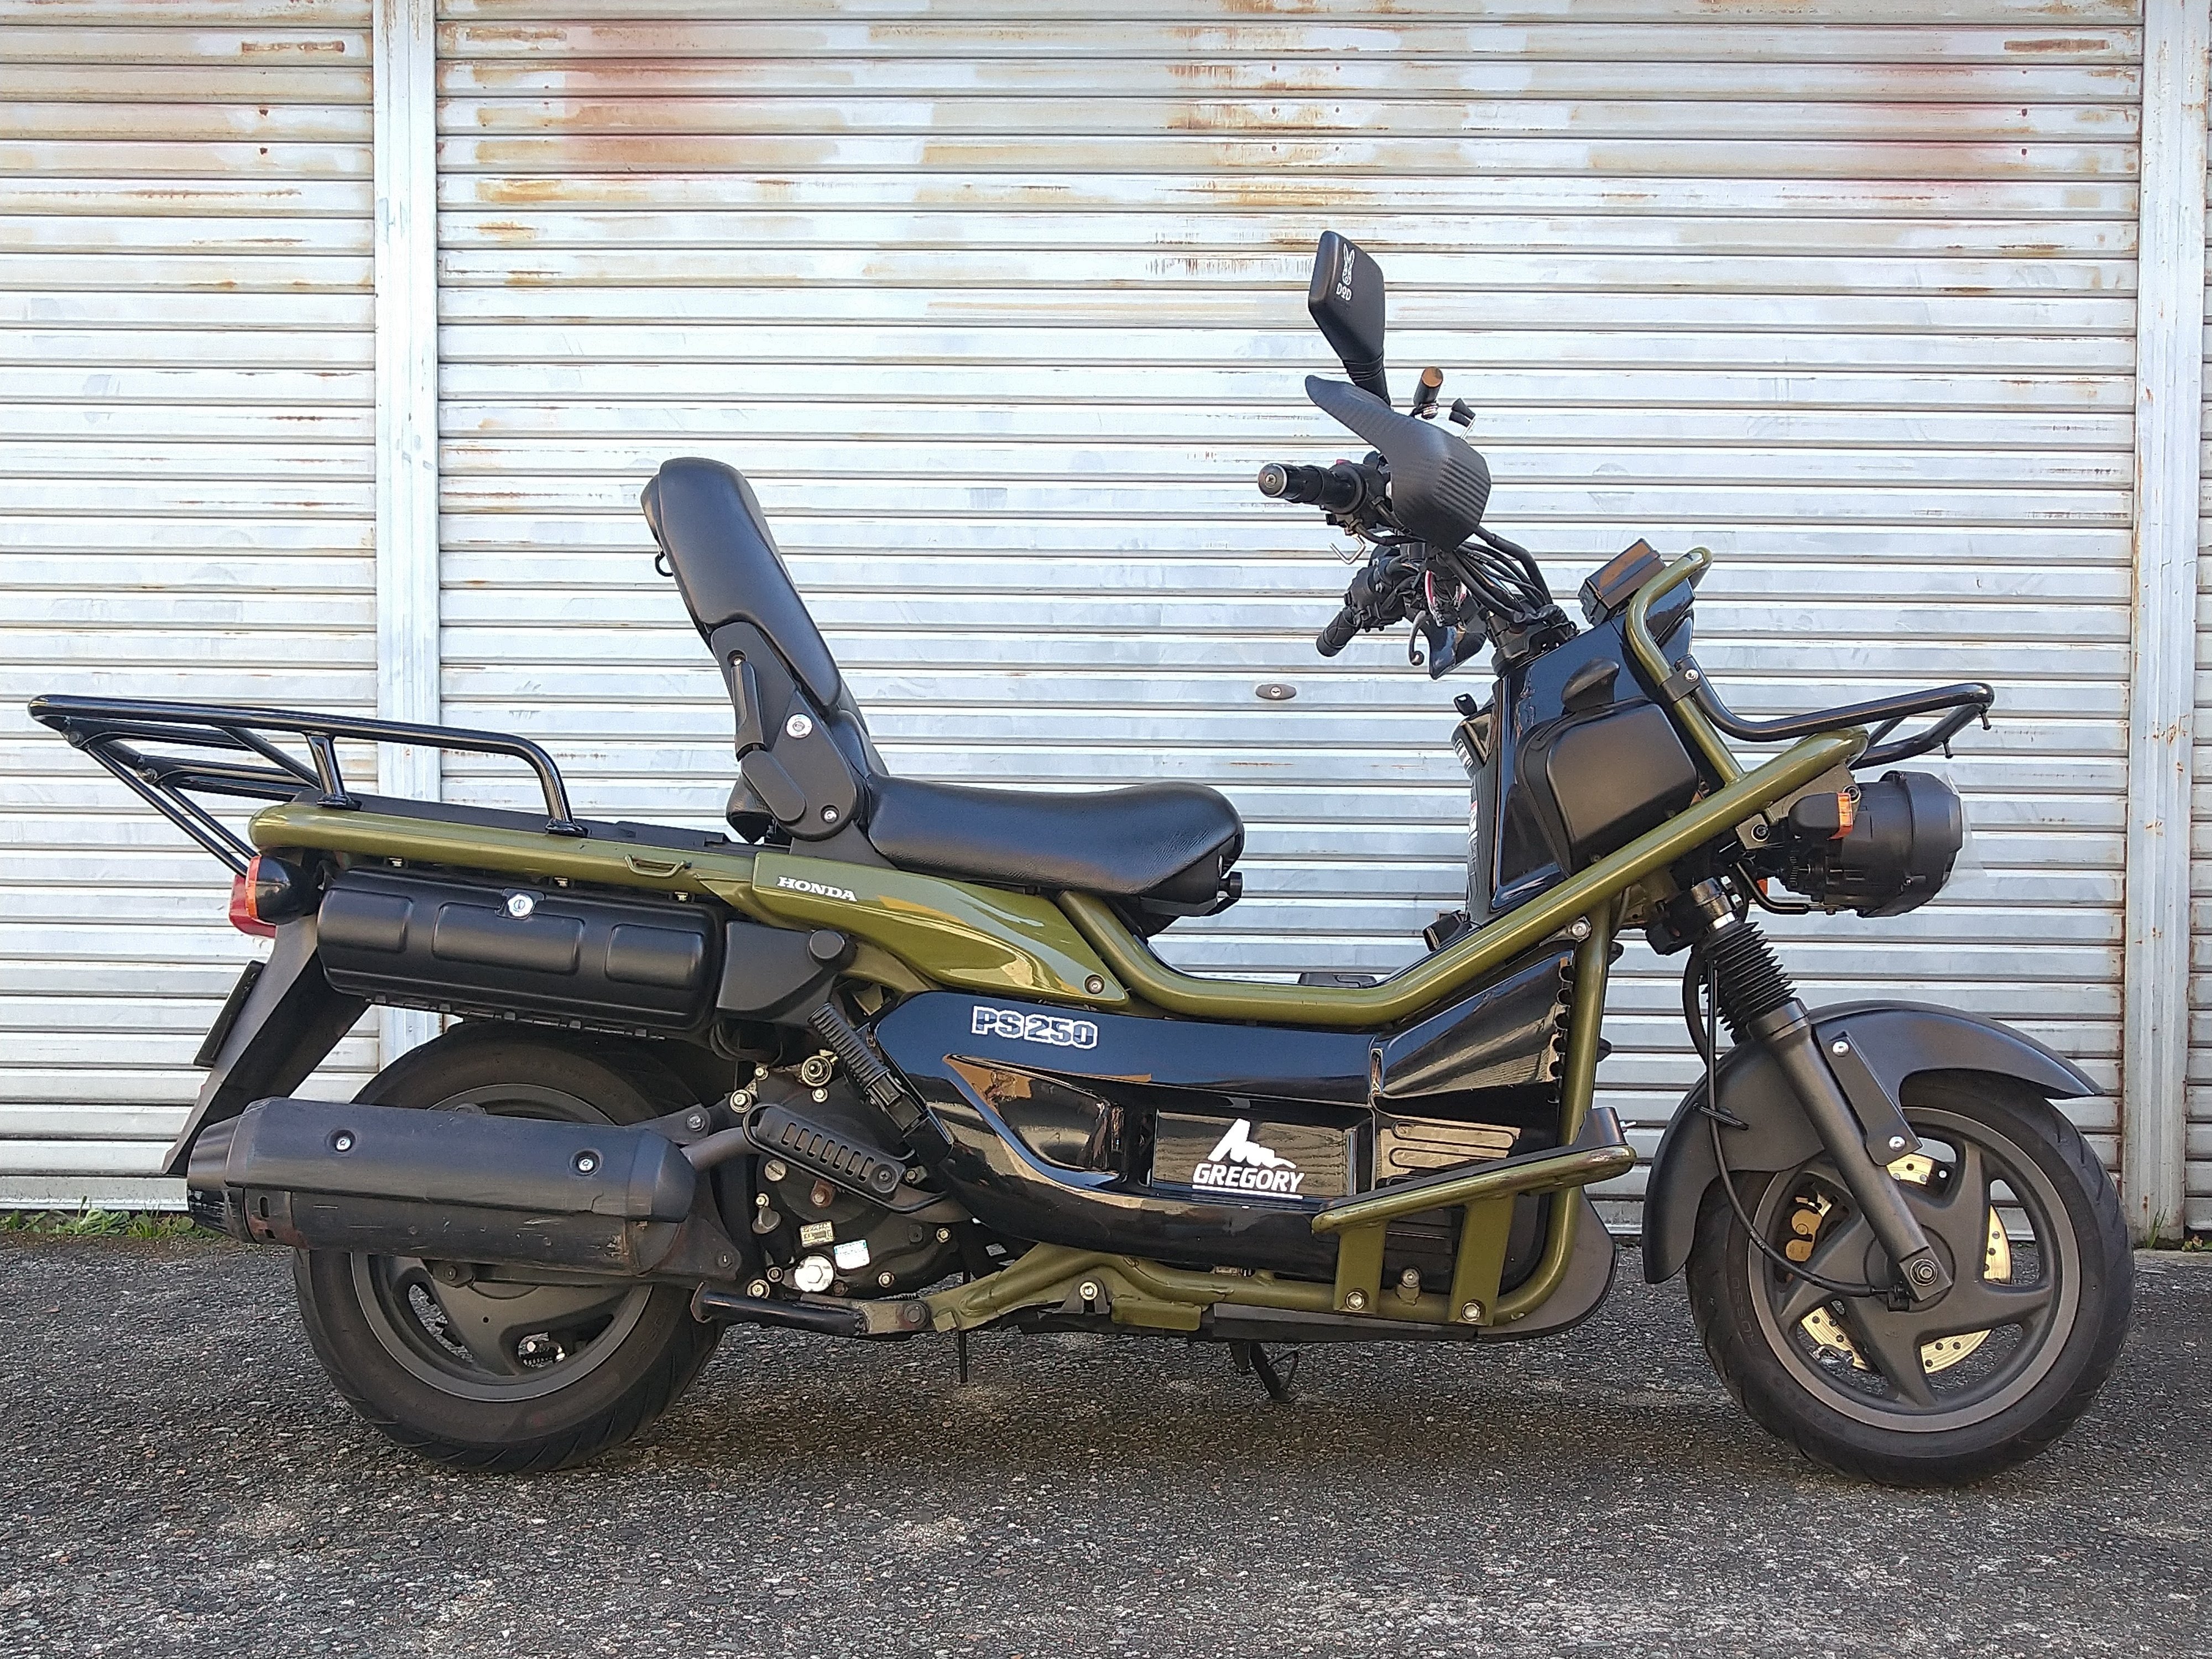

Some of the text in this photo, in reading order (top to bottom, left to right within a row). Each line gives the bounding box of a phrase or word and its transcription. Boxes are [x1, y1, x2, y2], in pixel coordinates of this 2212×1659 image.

[778, 876, 857, 902] HONDA
[972, 1006, 1098, 1050] PS250
[1193, 1163, 1305, 1192] GREGORY
